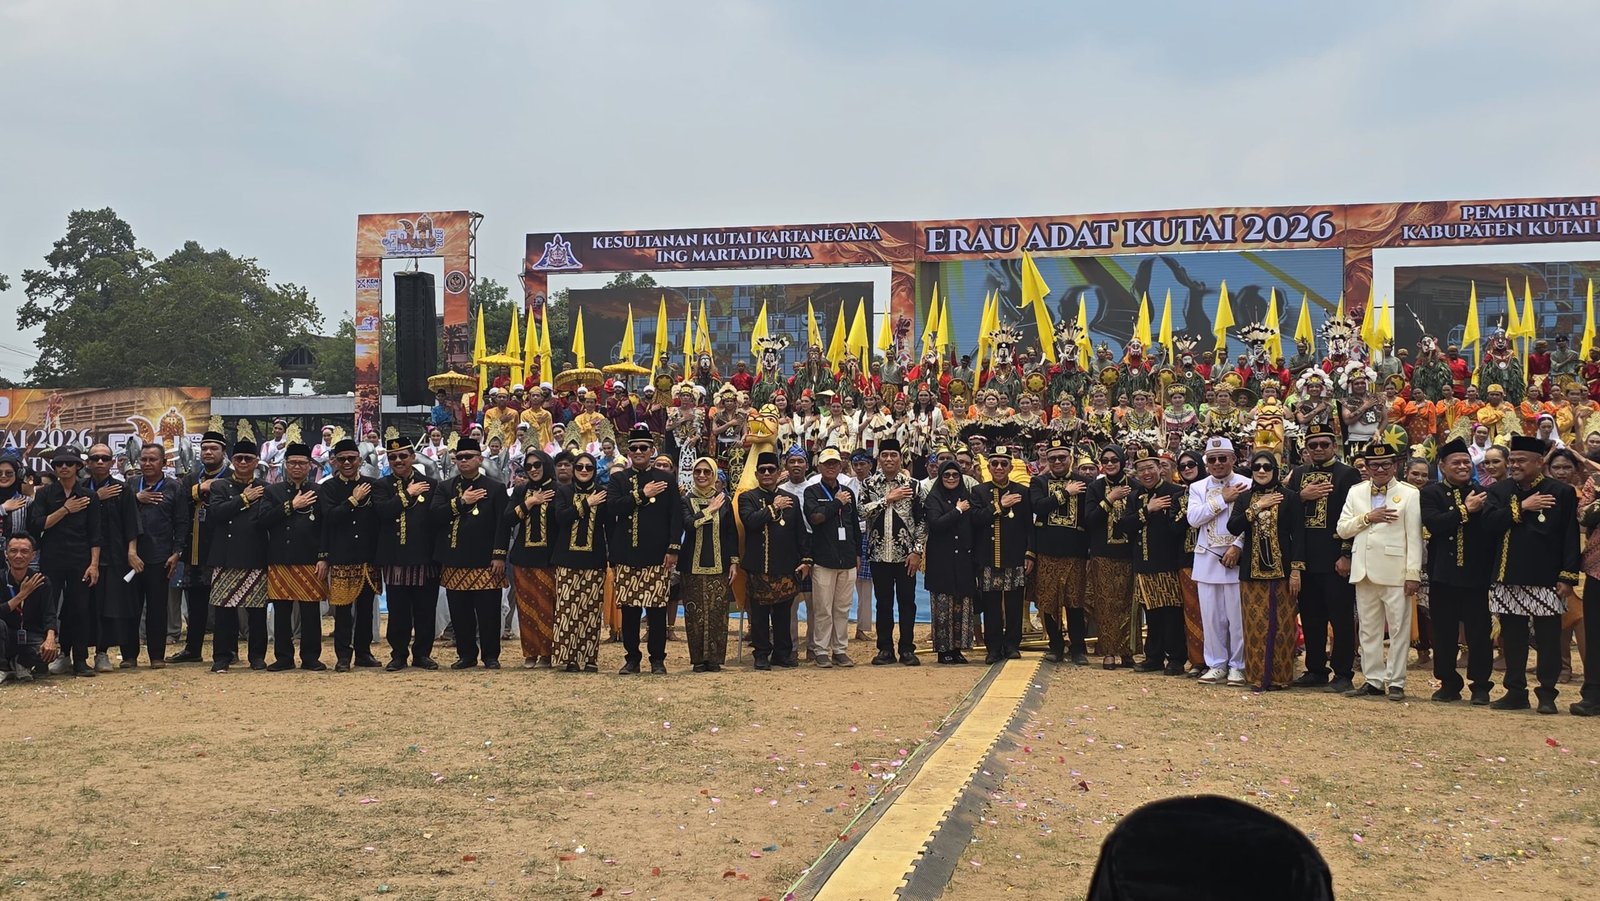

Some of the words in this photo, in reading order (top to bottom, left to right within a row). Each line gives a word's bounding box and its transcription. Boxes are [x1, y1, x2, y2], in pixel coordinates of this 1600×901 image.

[1461, 202, 1597, 220] PEMERINTAH
[592, 233, 698, 249] KESULTANAN
[702, 231, 752, 246] KUTAI
[756, 227, 881, 244] KARTANEGARA
[927, 226, 1017, 253] ERAU
[1025, 221, 1116, 249] ADAT
[1124, 216, 1236, 245] KUTAI
[1244, 213, 1333, 241] 2026
[1403, 222, 1522, 240] KABUPATEN
[1528, 220, 1591, 236] KUTAI
[657, 249, 688, 263] ING
[691, 245, 813, 262] MARTADIPURA
[34, 428, 93, 449] 2026
